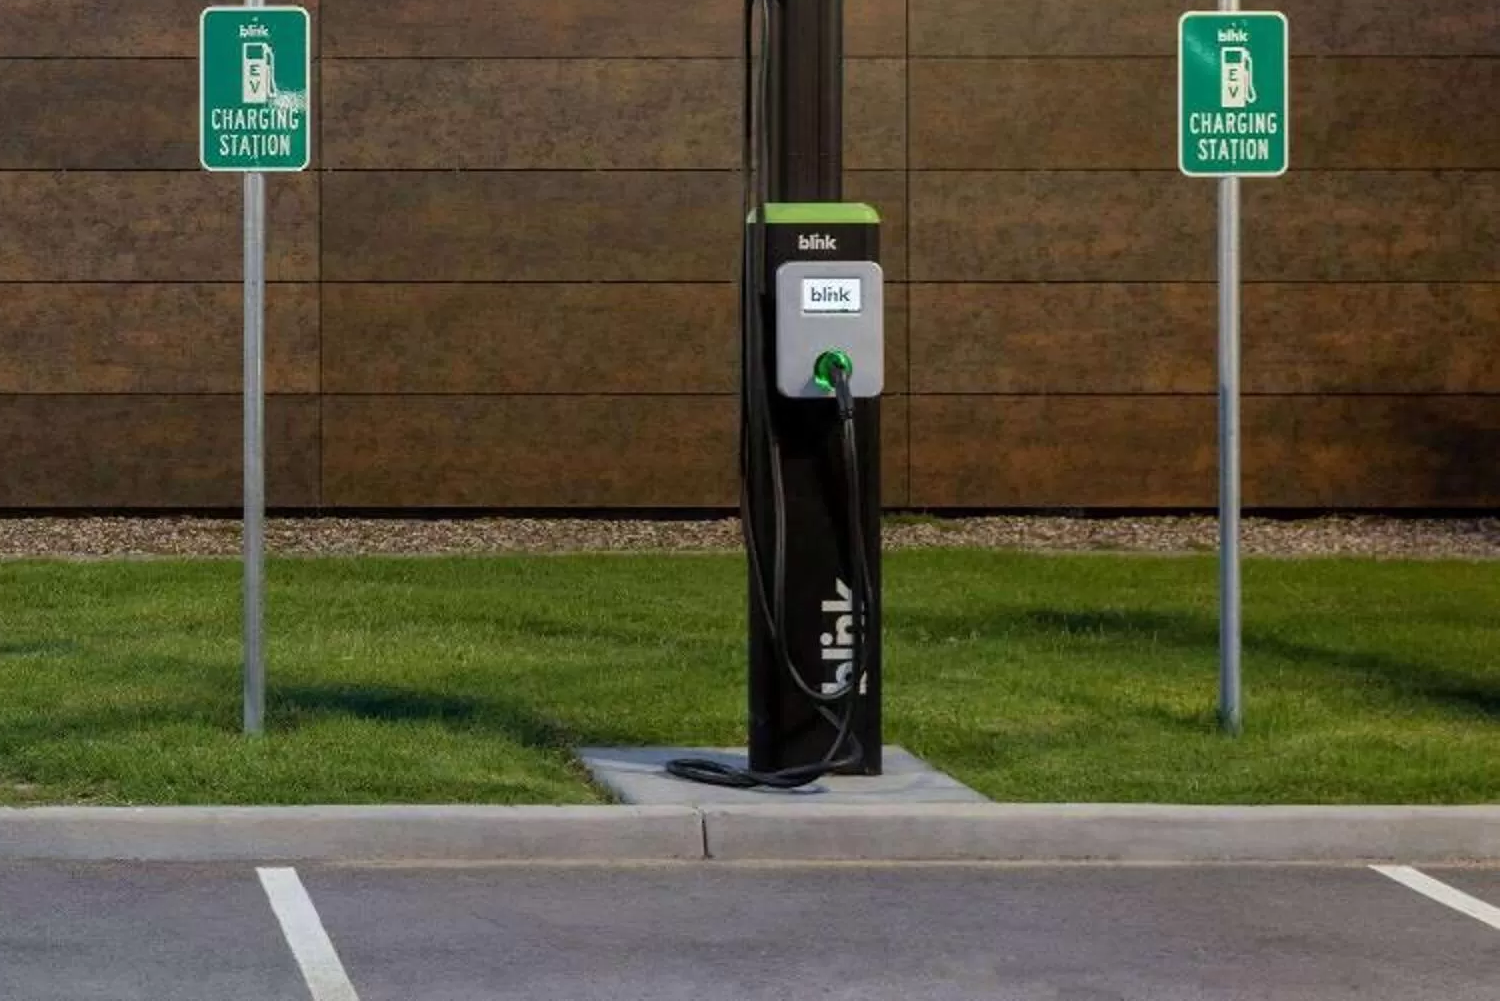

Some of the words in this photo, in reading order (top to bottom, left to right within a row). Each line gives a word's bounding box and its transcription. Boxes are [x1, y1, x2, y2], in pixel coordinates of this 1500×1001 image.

[239, 24, 269, 37] blink
[1217, 29, 1249, 42] blink
[211, 108, 299, 130] CHARGING
[1189, 112, 1277, 135] CHARGING
[219, 134, 291, 156] STATION
[1197, 138, 1269, 160] STATION
[798, 234, 836, 250] blink
[811, 286, 850, 302] blink
